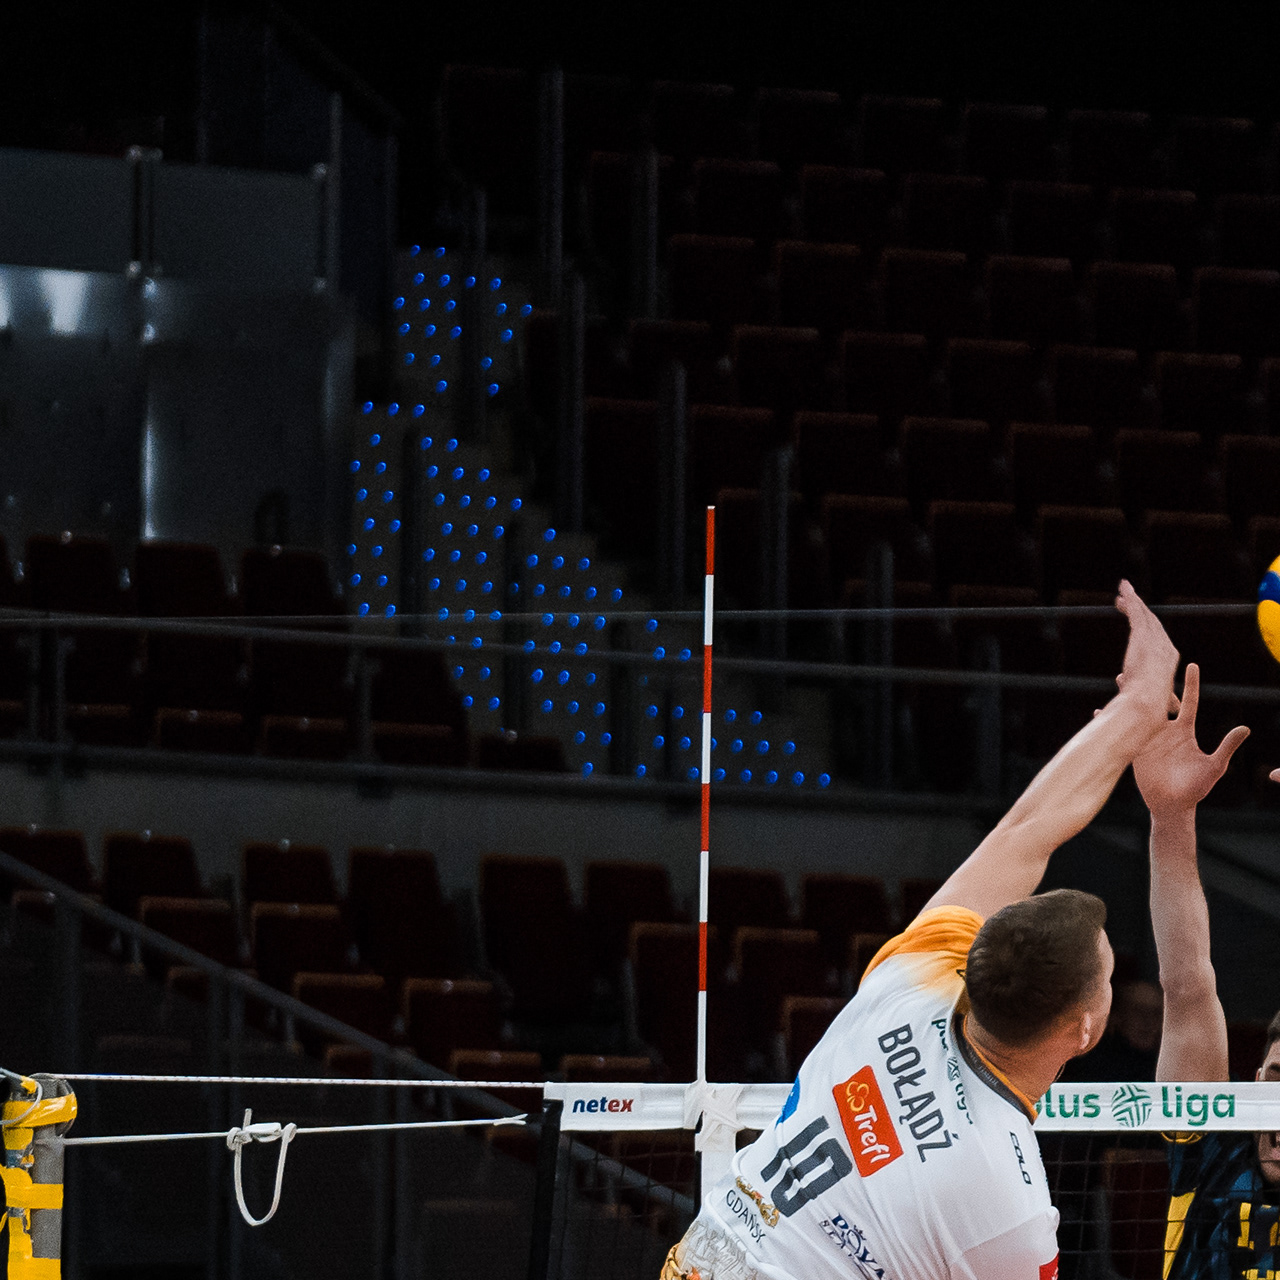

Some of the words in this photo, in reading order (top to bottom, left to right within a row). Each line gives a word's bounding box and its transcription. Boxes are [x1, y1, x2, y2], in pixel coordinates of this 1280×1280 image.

[573, 1095, 634, 1113] netex
[878, 1023, 960, 1163] BOŁĄDŹ
[1035, 1088, 1101, 1119] lus
[1161, 1087, 1236, 1126] liga
[852, 1106, 891, 1165] Trefl
